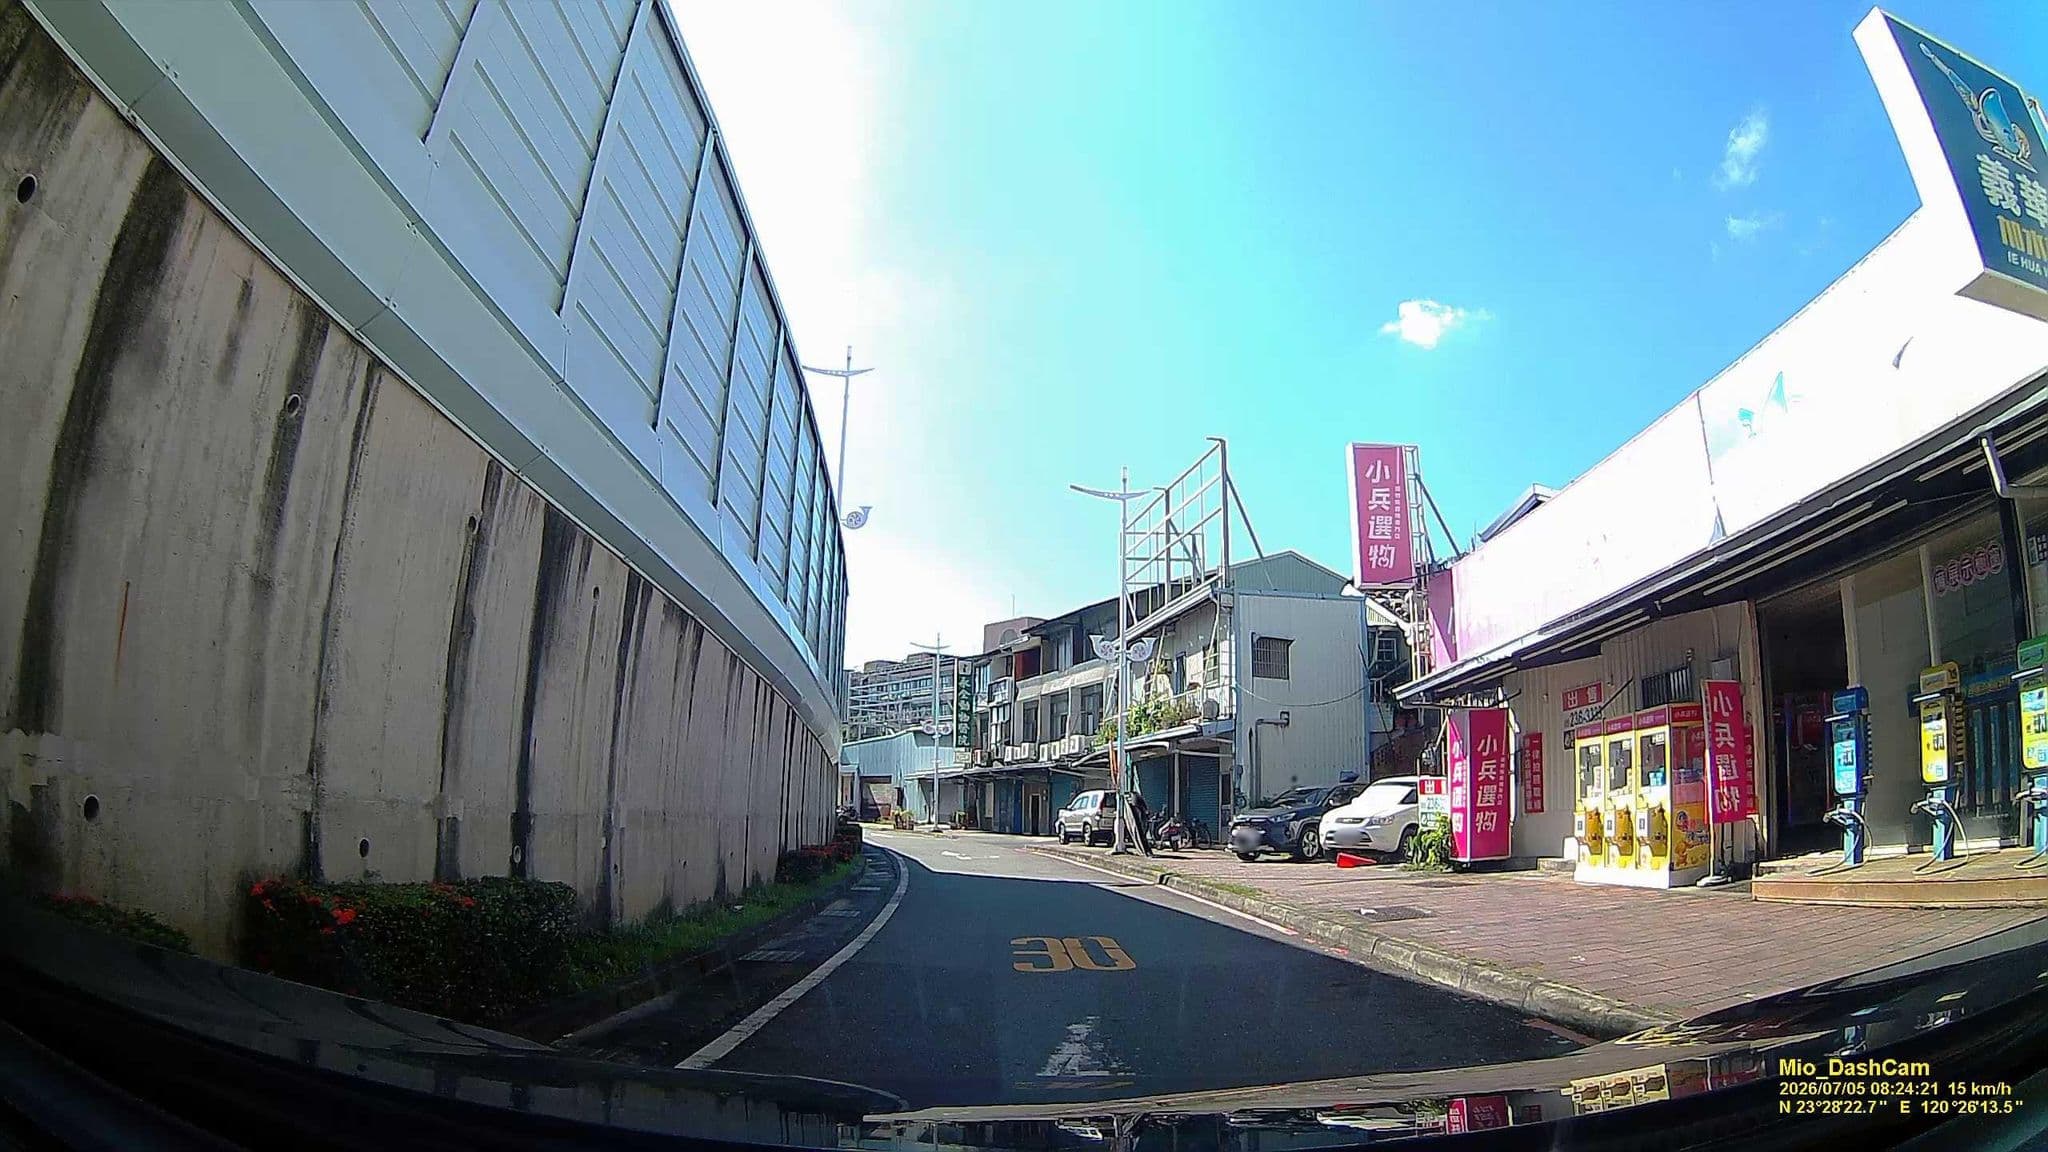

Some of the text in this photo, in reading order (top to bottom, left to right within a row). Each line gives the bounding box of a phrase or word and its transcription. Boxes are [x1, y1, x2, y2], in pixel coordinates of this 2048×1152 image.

[1976, 154, 2048, 229] 義華
[1997, 215, 2048, 262] 加水
[2020, 256, 2042, 276] HUA
[1365, 459, 1396, 569] 小兵選物
[1475, 734, 1498, 833] 小兵選物
[1010, 936, 1136, 971] 30
